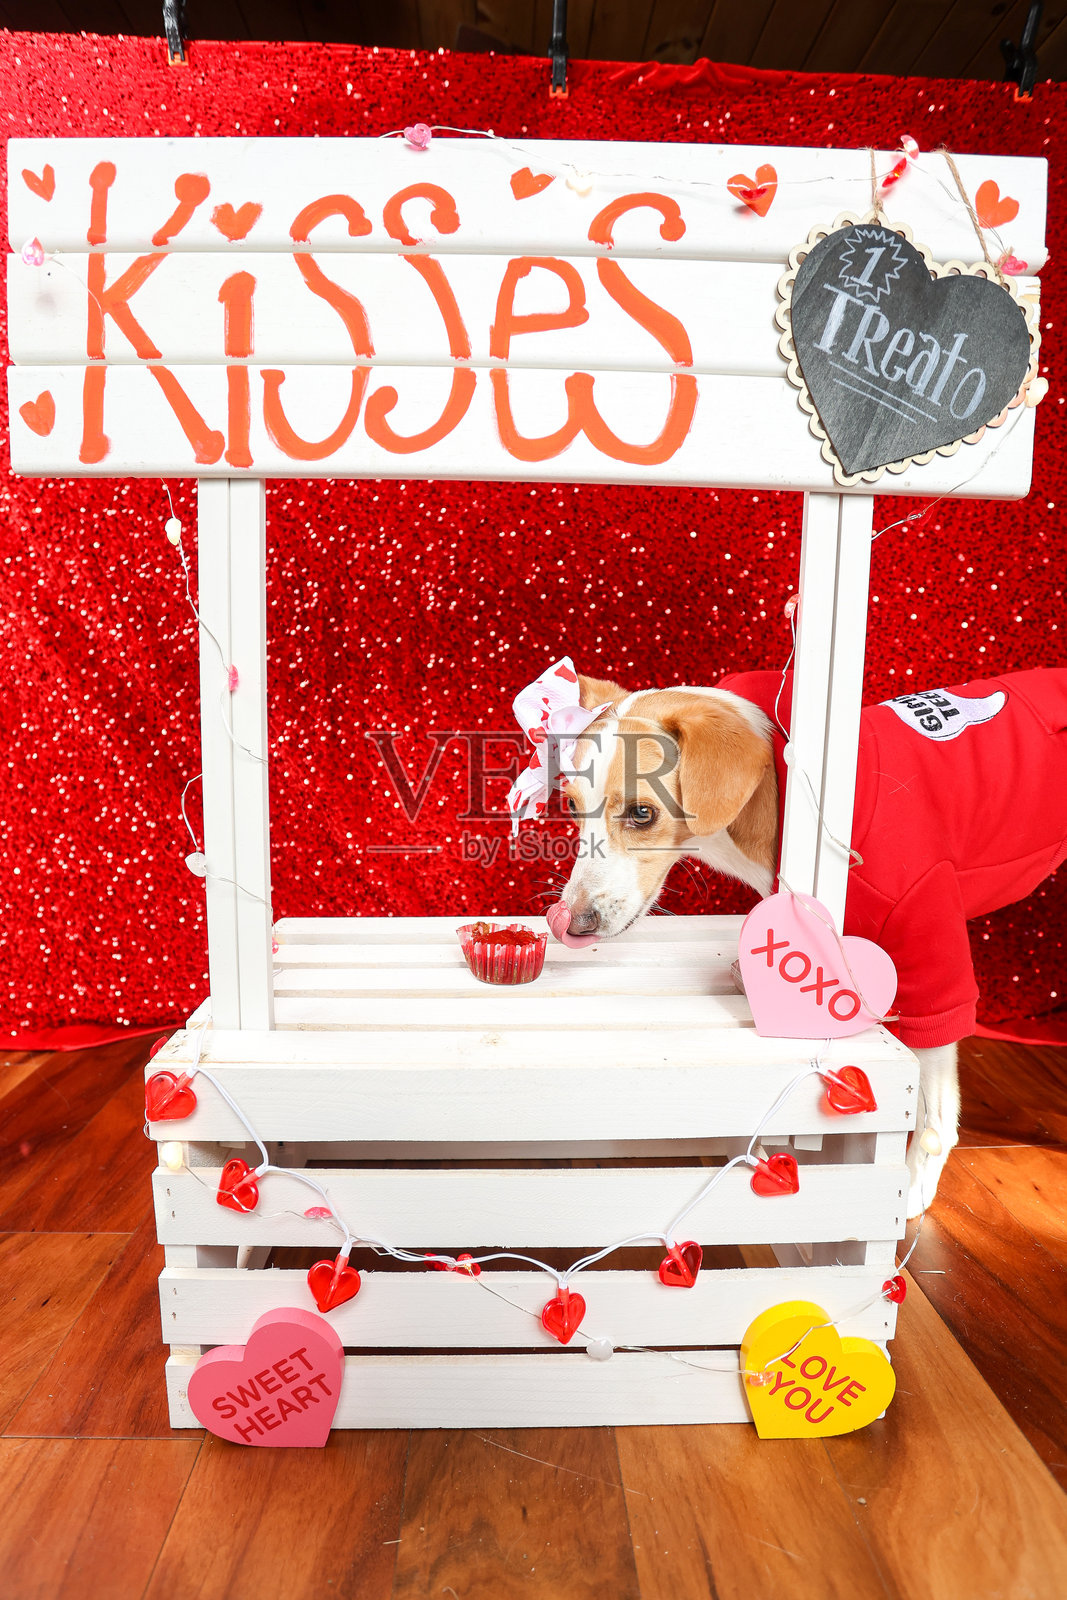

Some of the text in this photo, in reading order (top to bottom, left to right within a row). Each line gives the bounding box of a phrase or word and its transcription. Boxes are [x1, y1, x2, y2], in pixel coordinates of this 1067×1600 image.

[850, 246, 887, 288] 1
[750, 928, 862, 1022] XOXO
[212, 1347, 314, 1419] SWEET
[233, 1373, 332, 1443] HEART
[768, 1371, 835, 1424] YOU
[781, 1341, 867, 1407] LOVE
